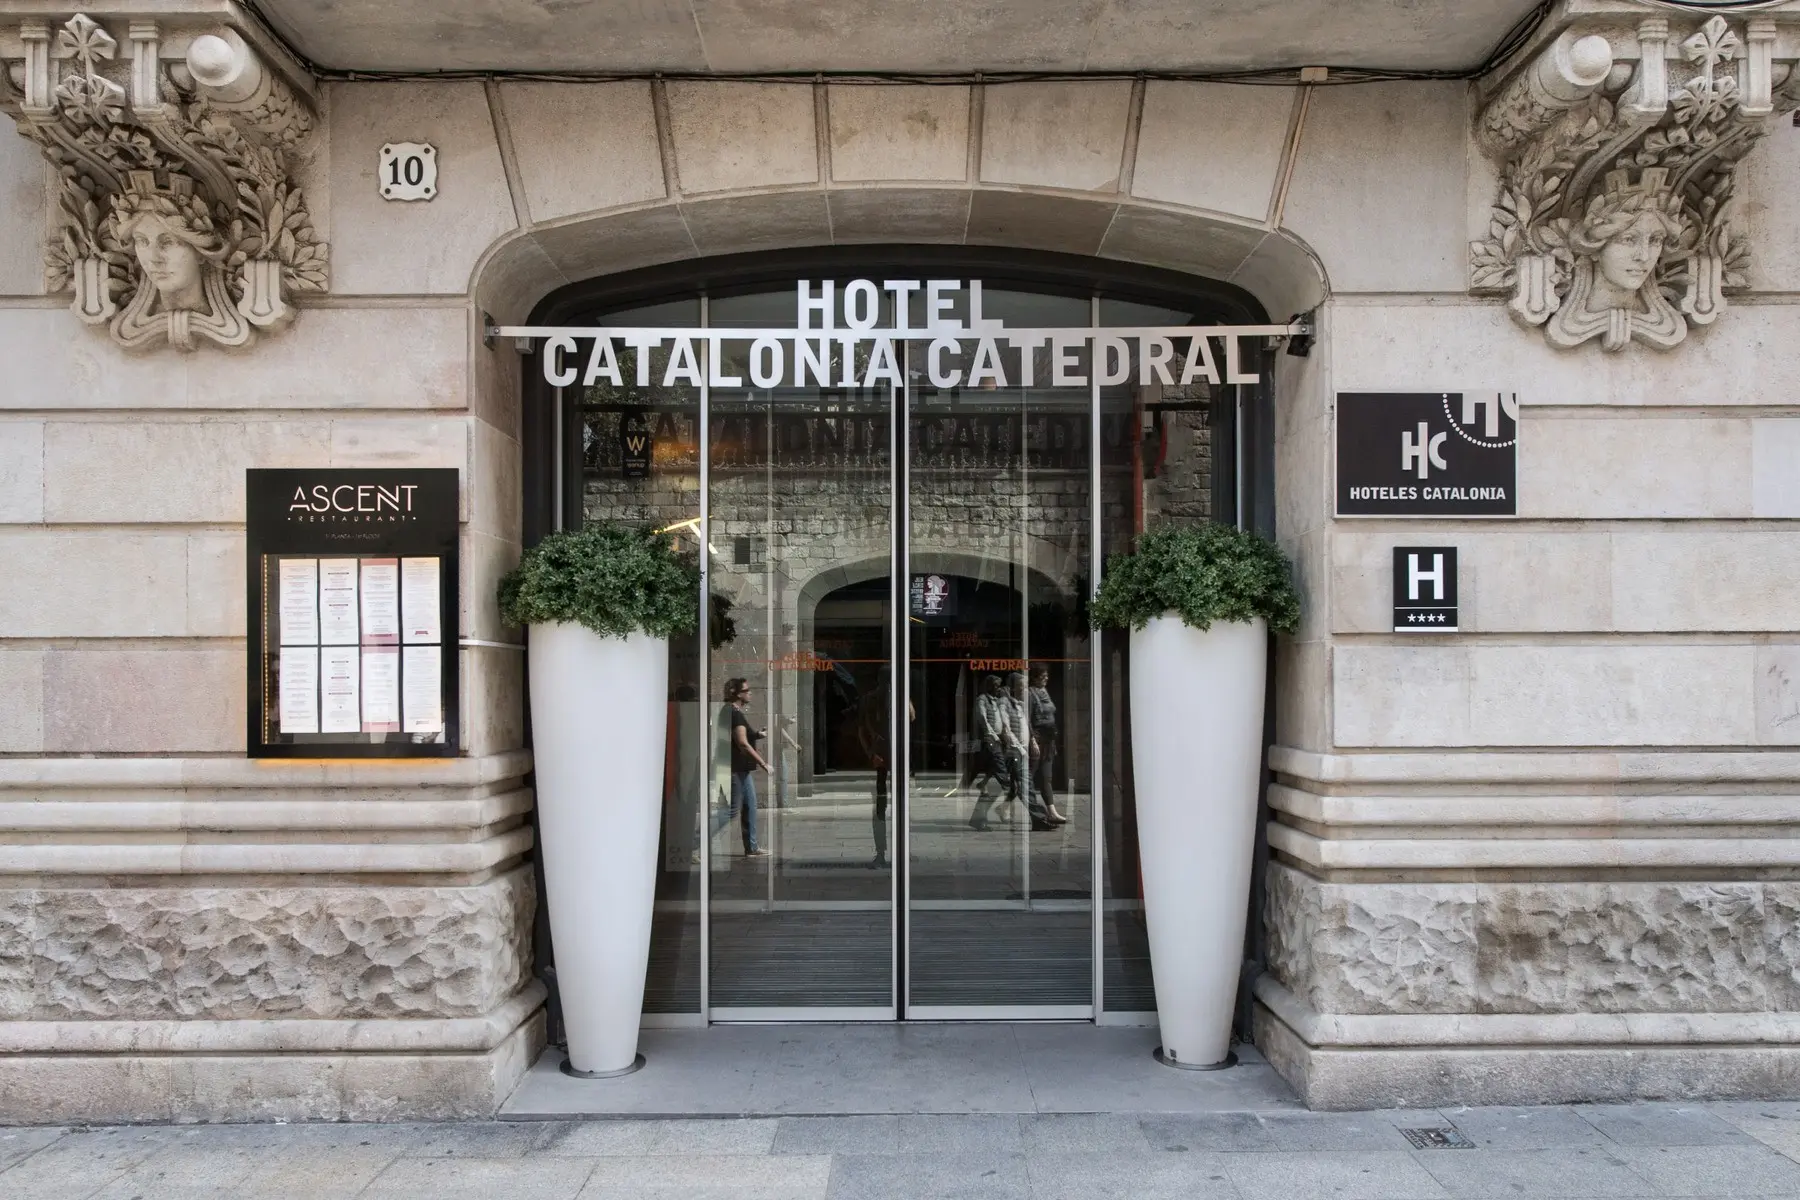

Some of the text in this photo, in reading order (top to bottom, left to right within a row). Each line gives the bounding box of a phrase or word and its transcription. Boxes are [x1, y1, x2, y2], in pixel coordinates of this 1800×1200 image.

[389, 156, 423, 185] 10
[797, 279, 1003, 331] HOTEL
[543, 334, 1260, 388] CATALONIA CATEDRAL
[1402, 422, 1447, 480] HC
[290, 485, 418, 512] ASCENT
[1350, 487, 1506, 500] HOTELES CATALONIA
[298, 515, 406, 523] RESTAURANT
[1408, 553, 1444, 600] H
[970, 660, 1031, 671] CATEDRAL
